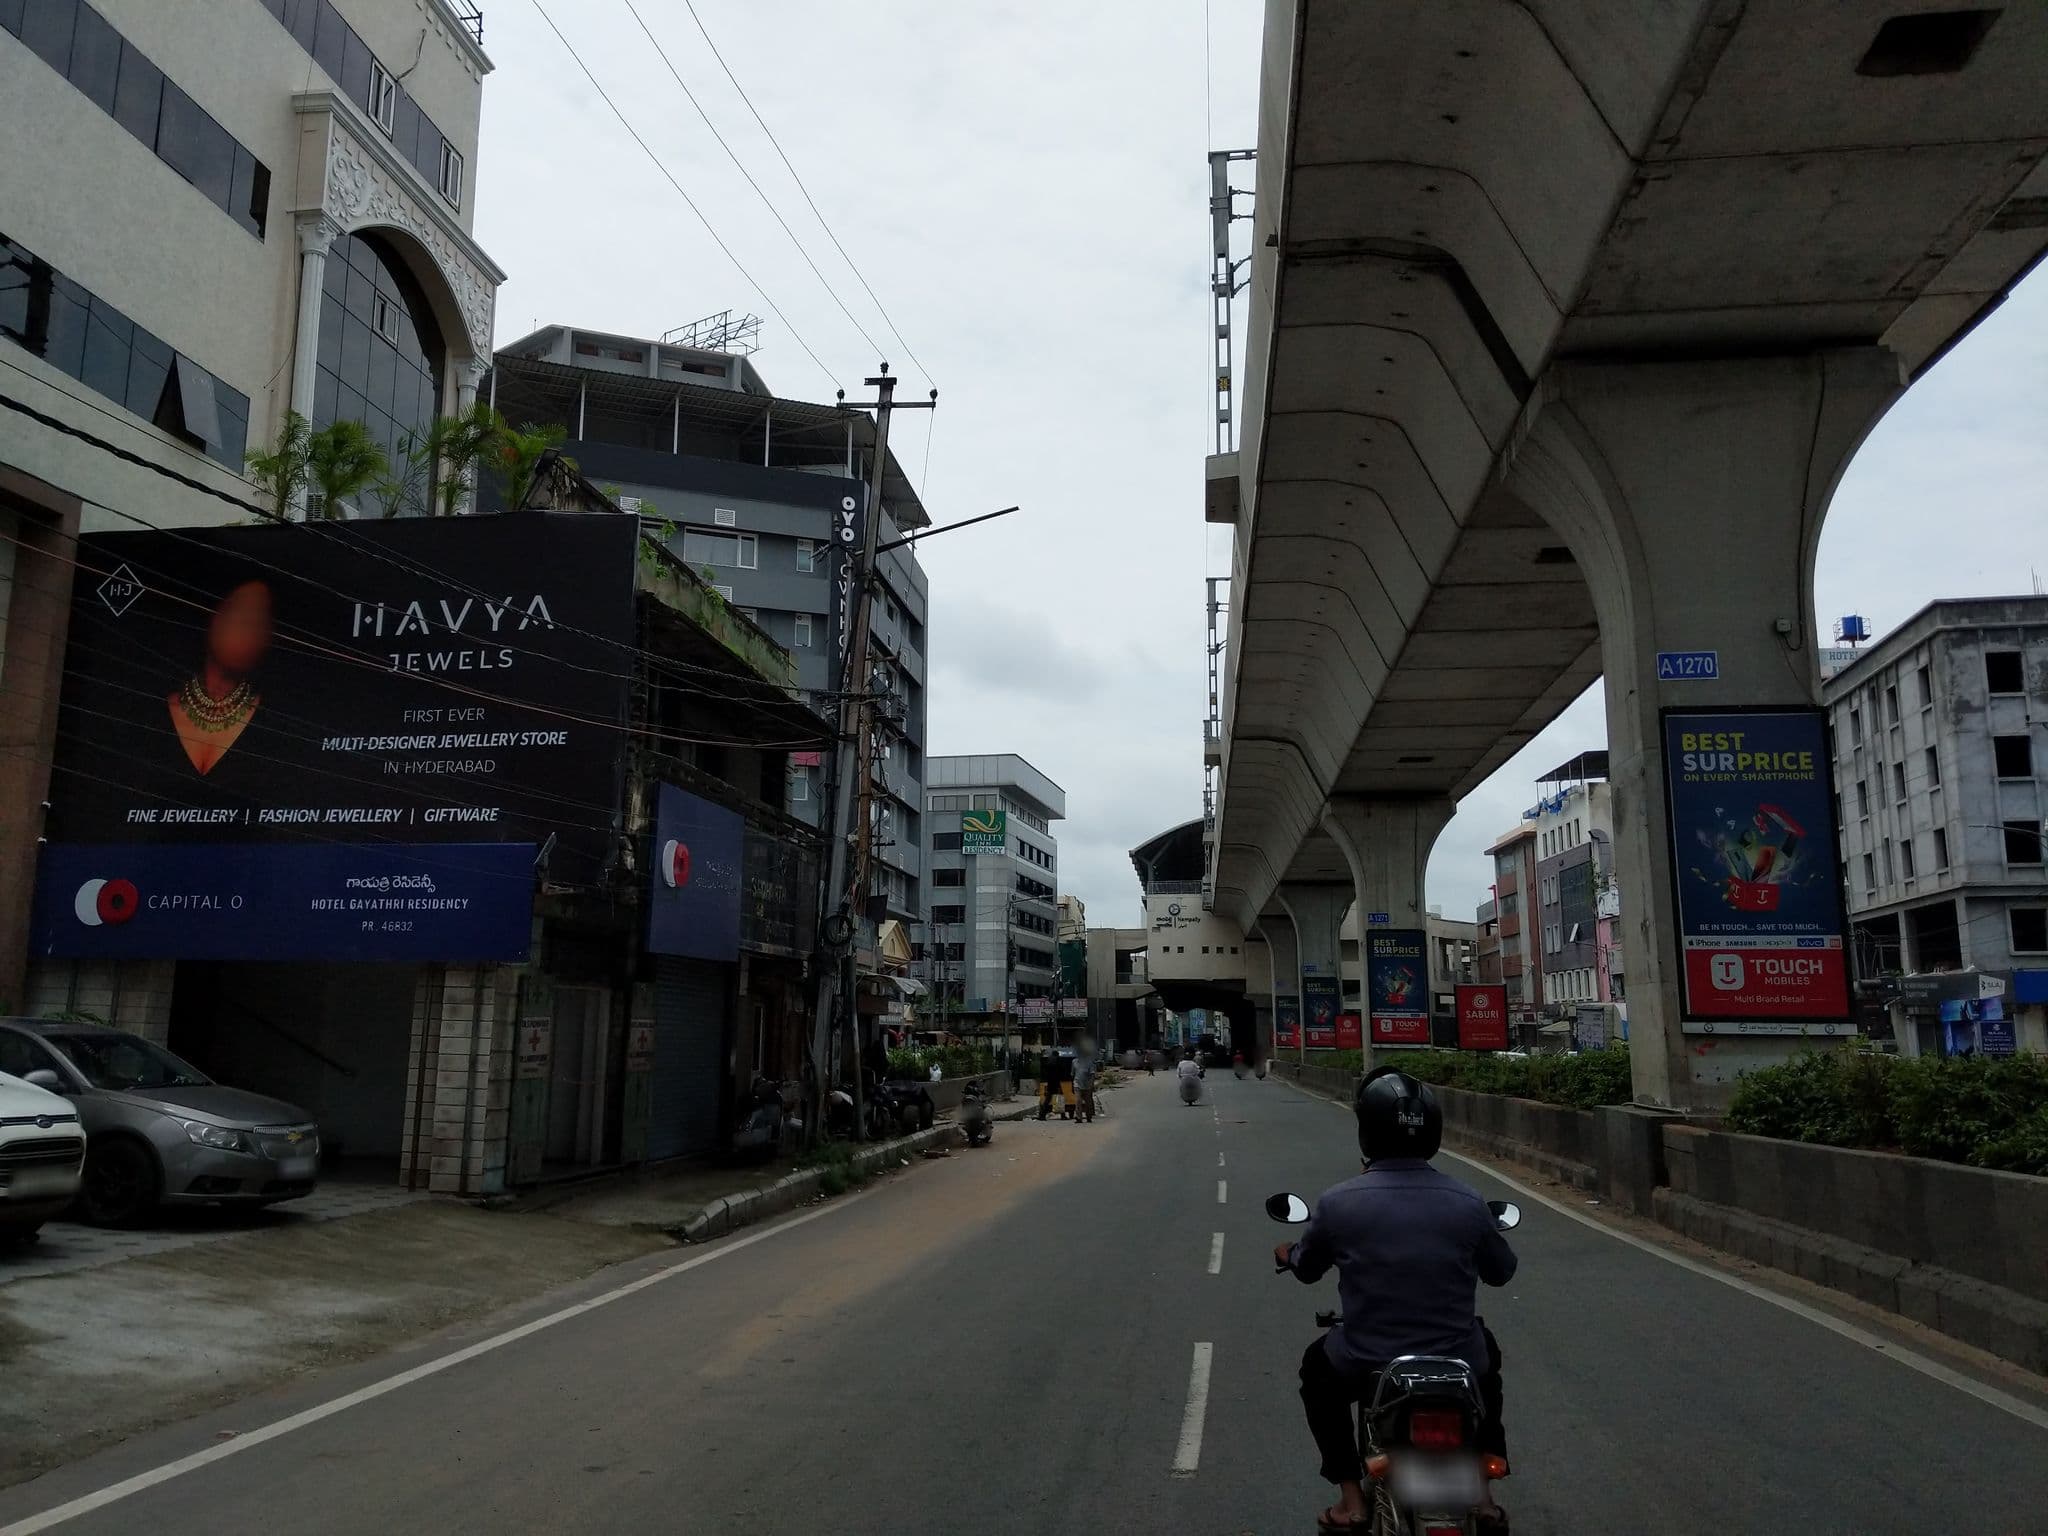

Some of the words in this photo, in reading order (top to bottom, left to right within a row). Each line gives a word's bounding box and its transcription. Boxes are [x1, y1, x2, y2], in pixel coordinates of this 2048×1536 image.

[841, 496, 856, 542] OYO
[352, 595, 555, 637] HAVYA
[387, 649, 514, 673] JEWELS
[1661, 657, 1674, 675] A
[1676, 656, 1714, 675] 1270
[404, 709, 443, 723] FIRST
[448, 708, 485, 722] EVER
[438, 733, 520, 748] JEWELLERY
[520, 731, 568, 746] STORE
[1681, 732, 1745, 752] BEST
[383, 761, 399, 774] IN
[404, 760, 496, 774] HYDERABAD
[1682, 751, 1814, 772] SURPRICE
[1683, 773, 1700, 782] ON
[1703, 772, 1739, 782] EVERY
[1741, 771, 1816, 781] SMARTPHONE
[127, 809, 158, 823] FINE
[160, 809, 238, 823] JEWELLERY
[322, 808, 403, 823] JEWELLERY
[424, 807, 499, 822] GIFTWARE
[964, 833, 1003, 842] QUALITY
[148, 895, 222, 910] CAPITAL
[311, 899, 346, 910] HOTEL
[350, 899, 404, 910] GAYATHRI
[408, 898, 469, 910] RESIDENCY
[381, 921, 413, 931] 46832
[1700, 923, 1710, 931] BE
[1711, 923, 1720, 931] IN
[1756, 923, 1778, 931] SAVE
[1778, 923, 1794, 931] TOO
[1373, 946, 1420, 954] SURPRICE
[1750, 958, 1824, 975] TOUCH
[1765, 976, 1810, 986] MOBILES
[1465, 1010, 1500, 1019] SABURI
